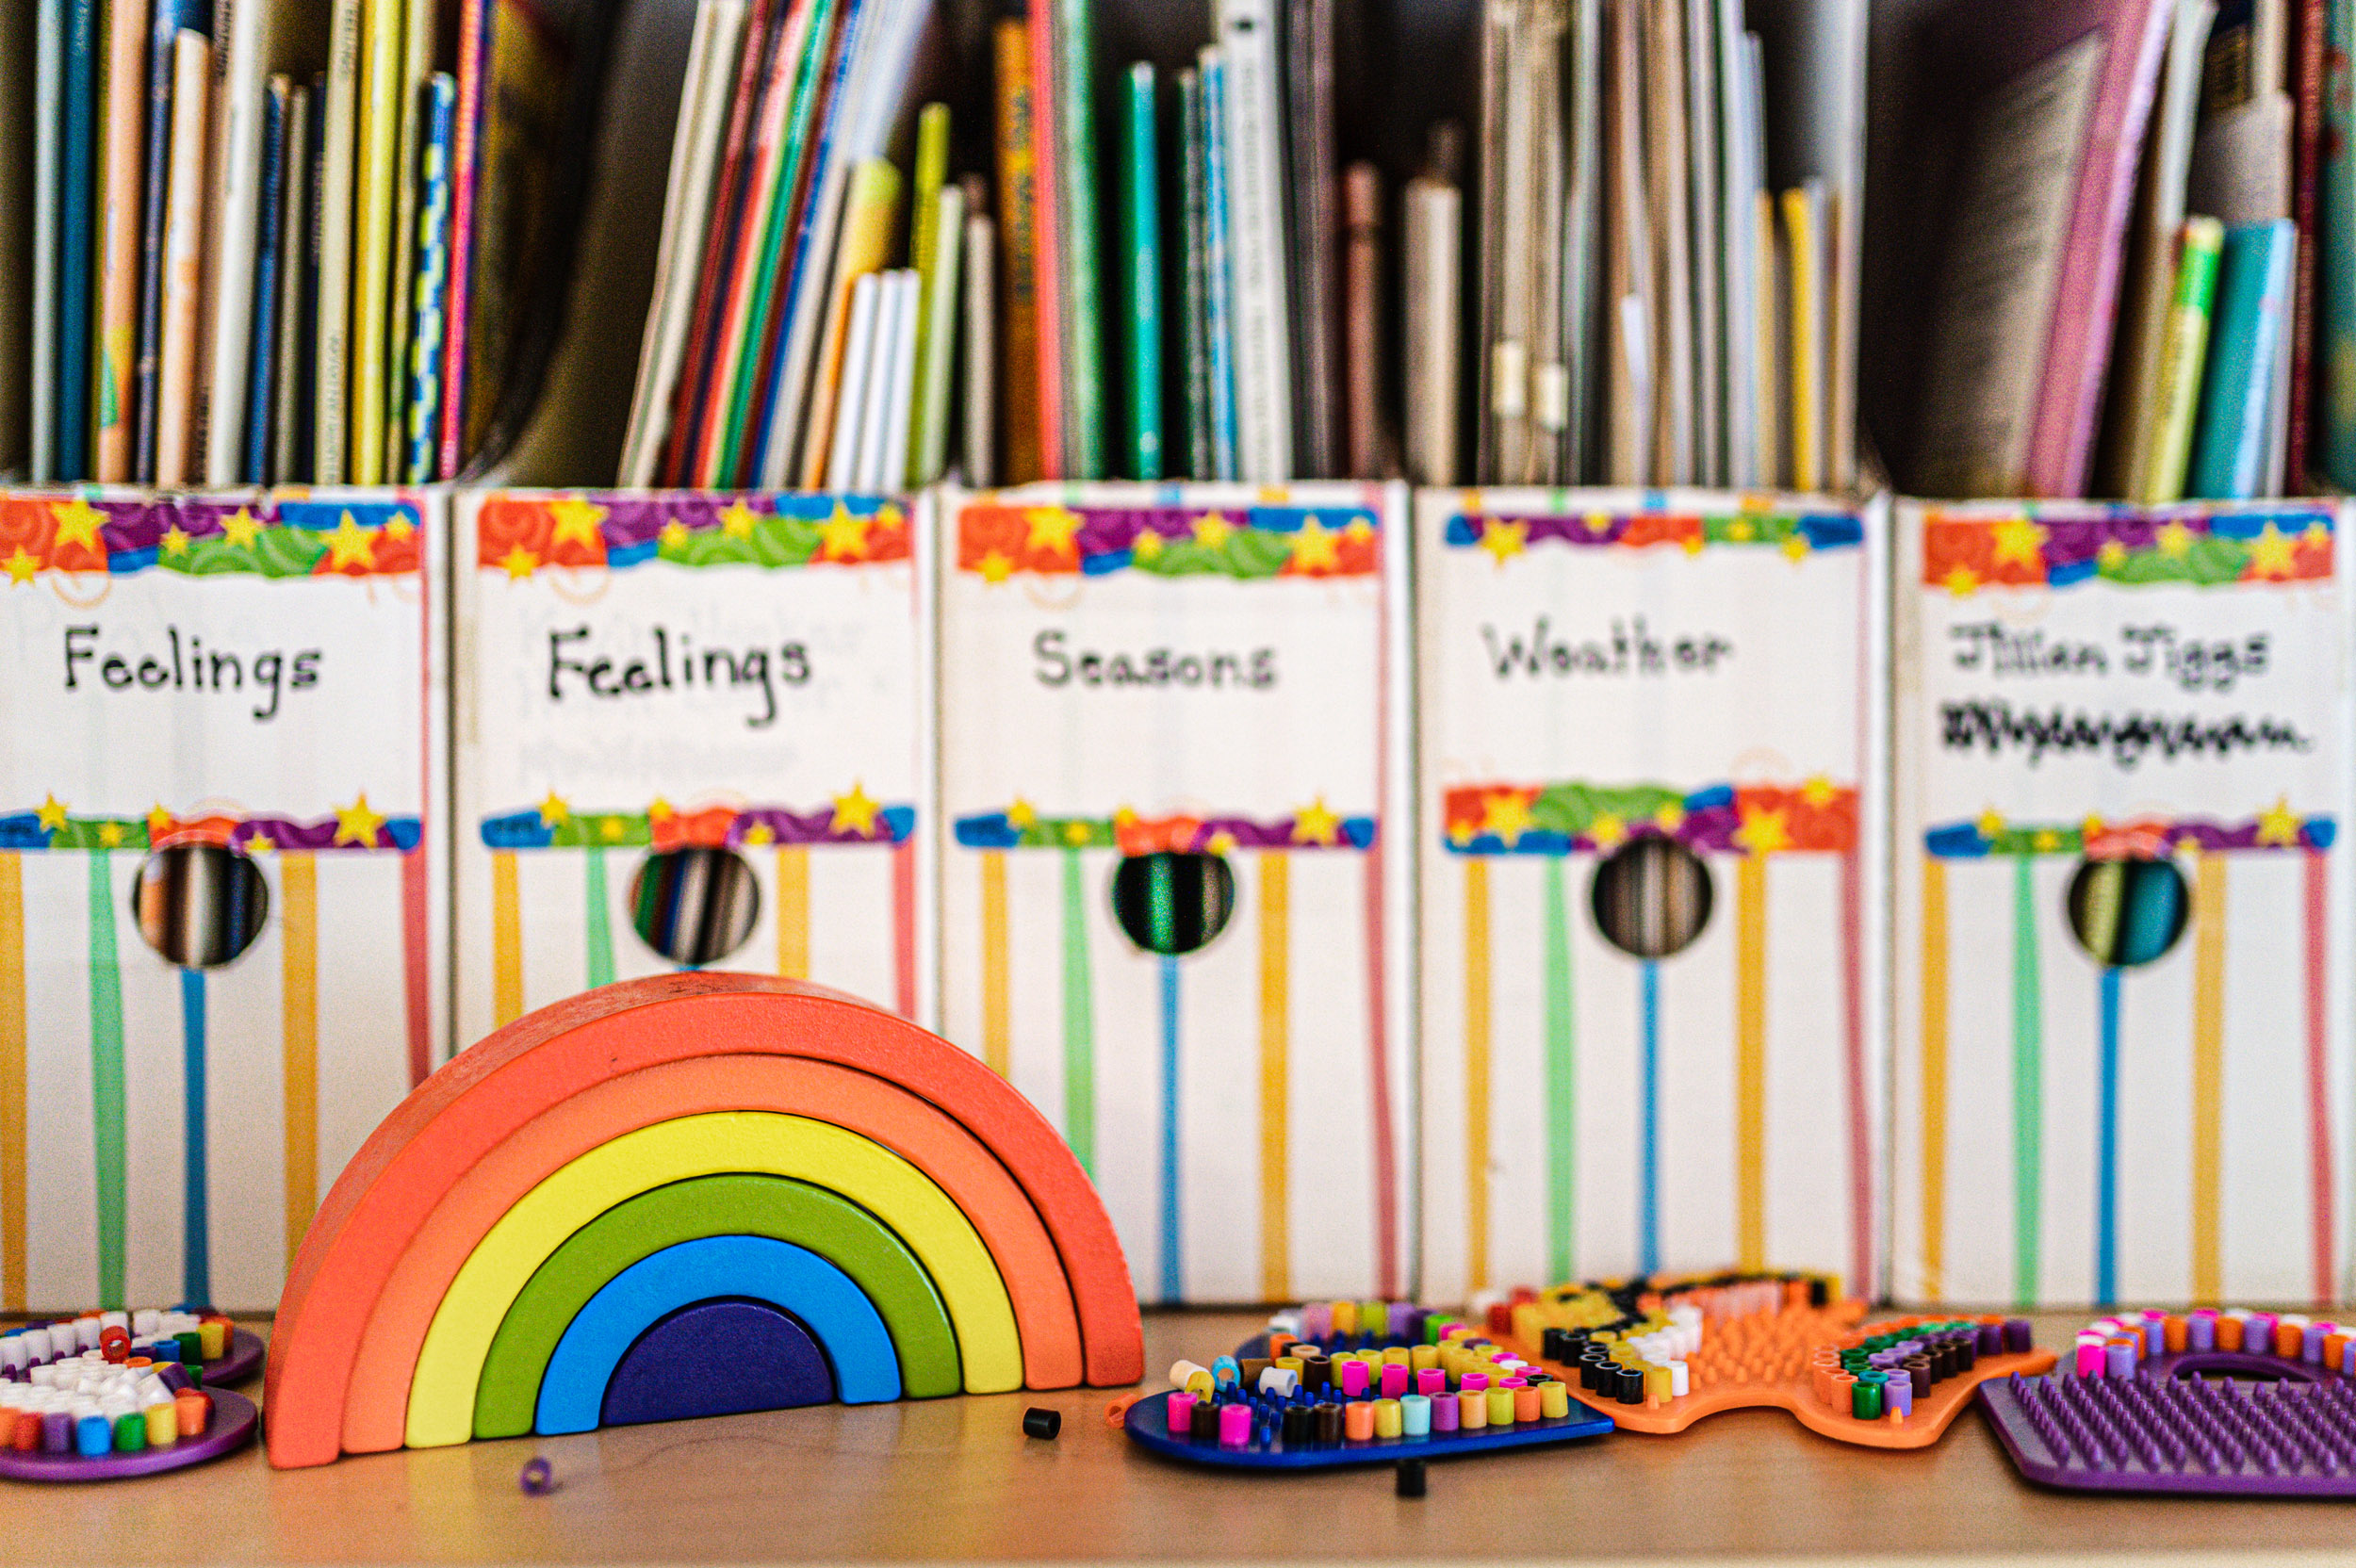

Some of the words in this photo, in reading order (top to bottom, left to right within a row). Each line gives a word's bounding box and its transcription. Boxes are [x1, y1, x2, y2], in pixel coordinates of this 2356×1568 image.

[63, 623, 322, 723] Feelings
[547, 624, 811, 728] Feelings
[1033, 629, 1277, 689] Seasons
[1481, 613, 1733, 678] Weather
[2119, 624, 2270, 694] Jiggs
